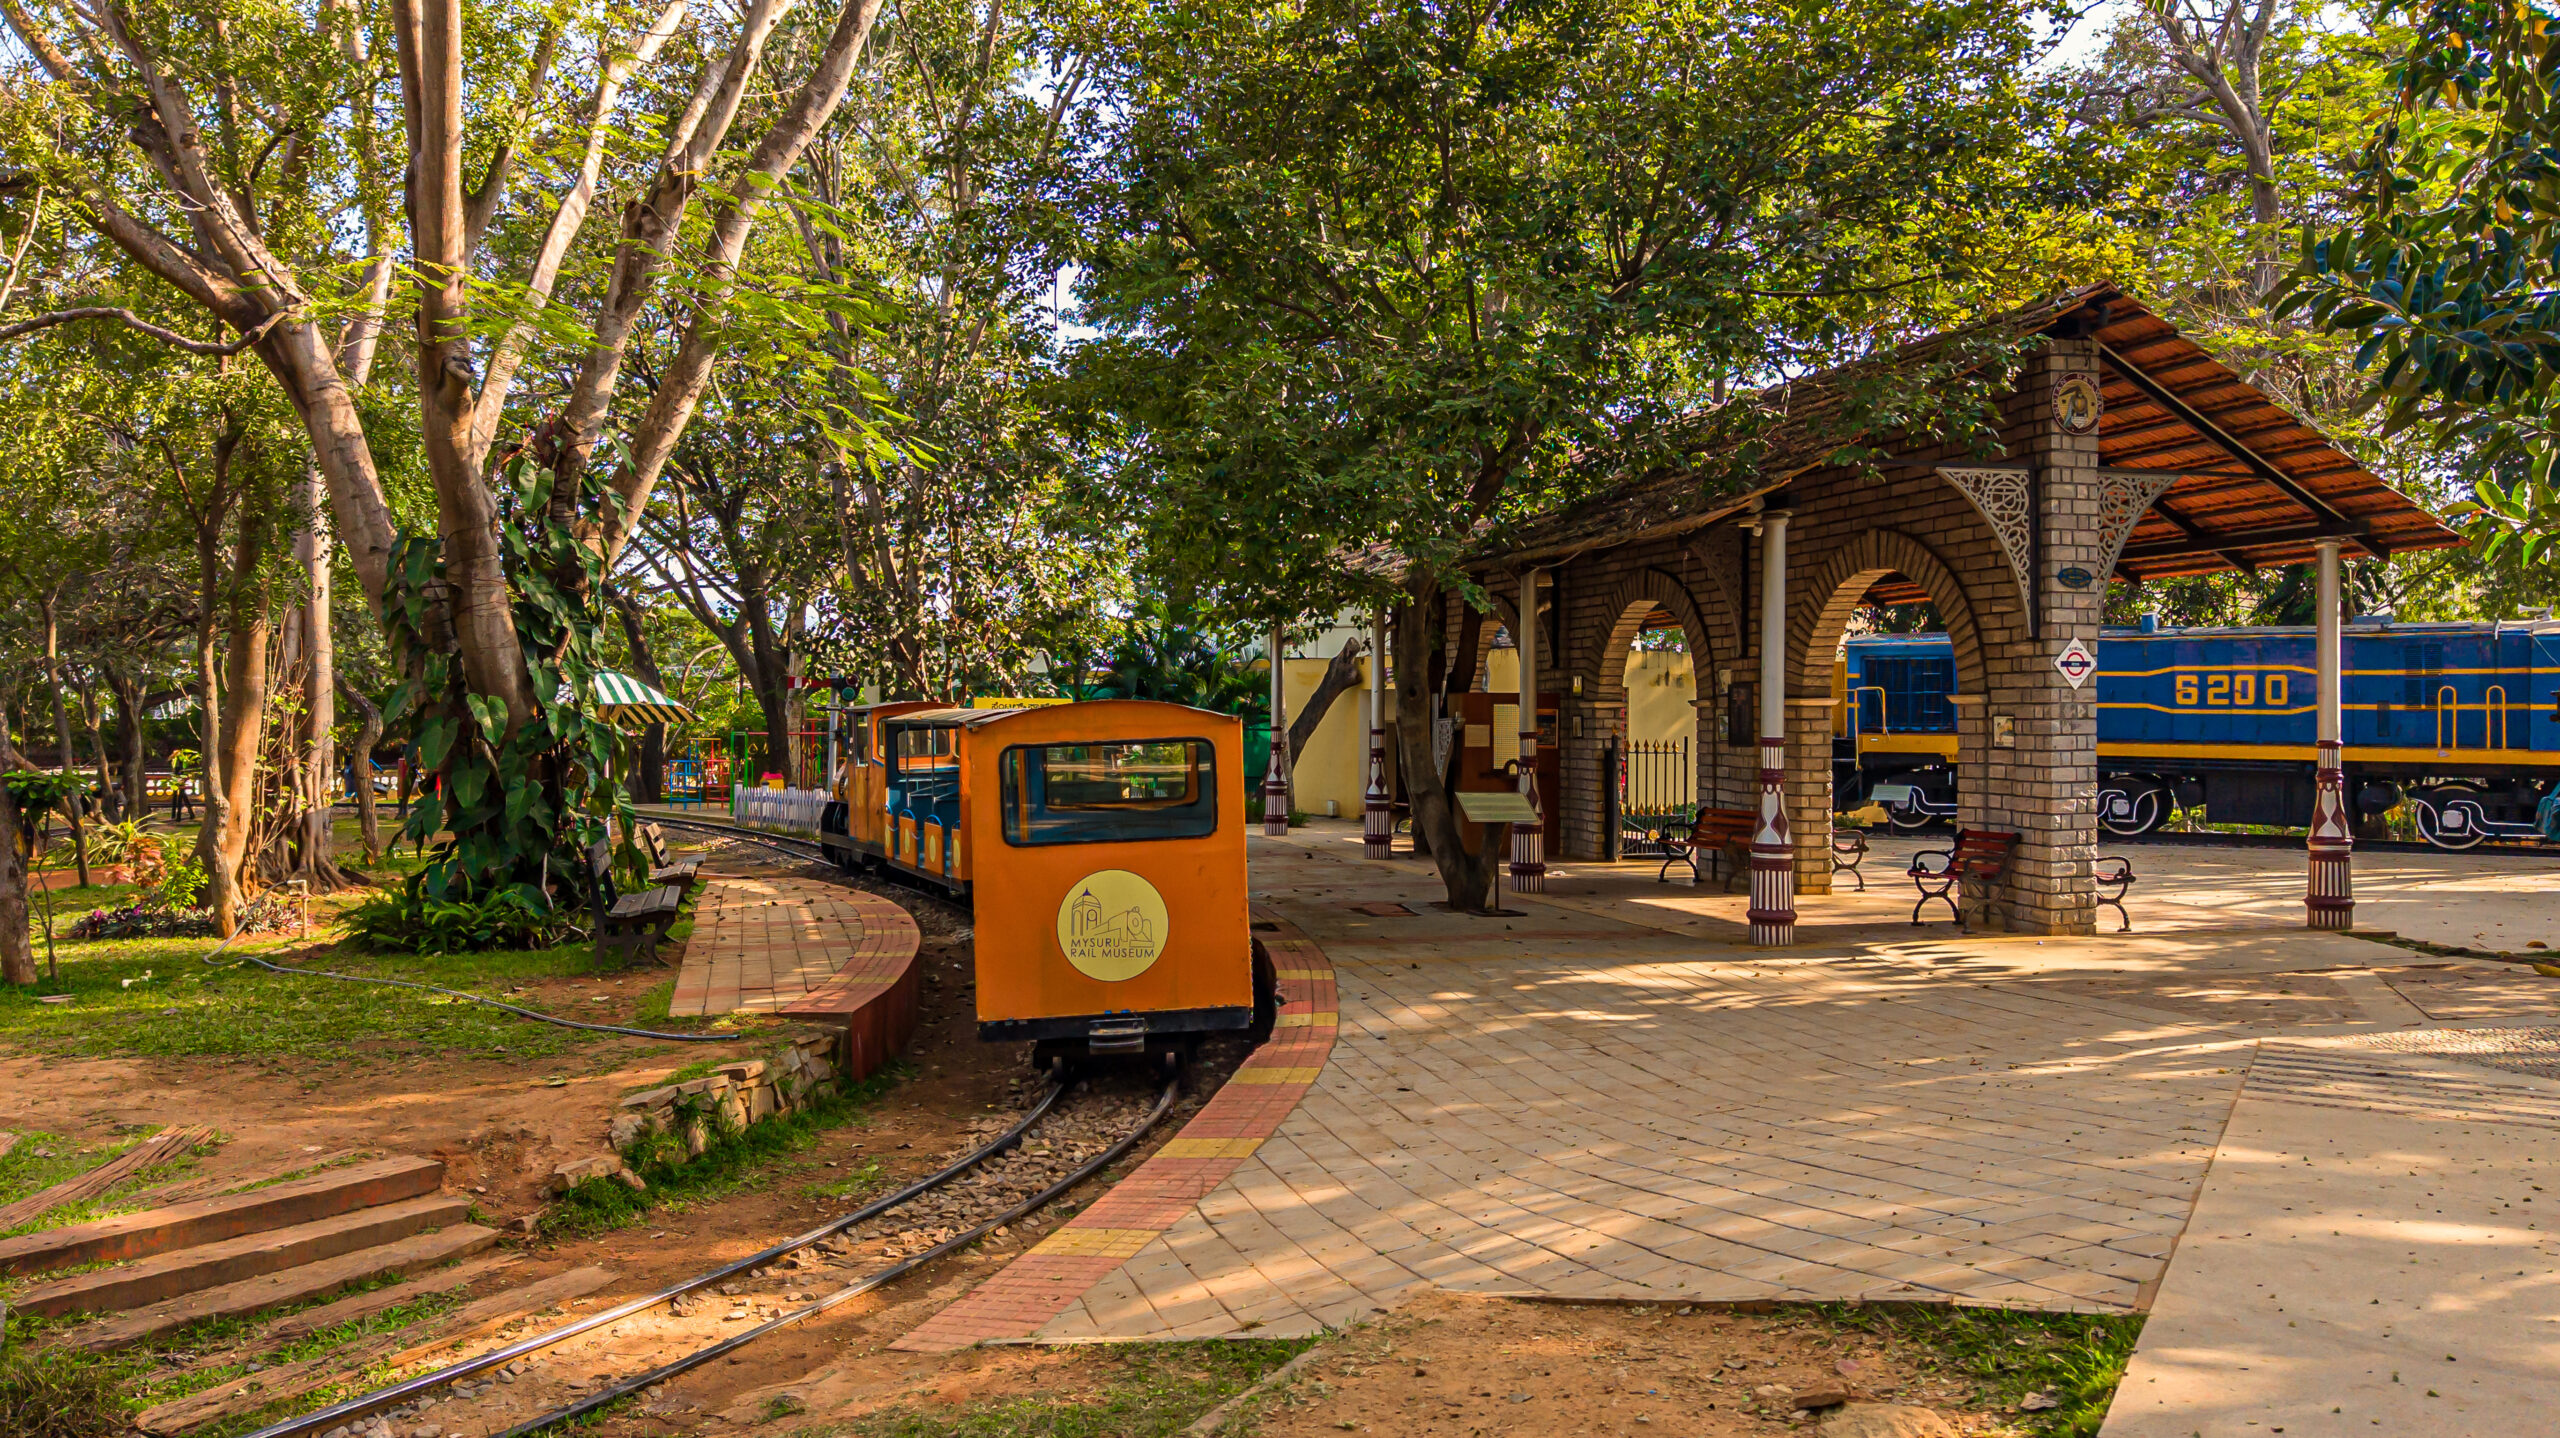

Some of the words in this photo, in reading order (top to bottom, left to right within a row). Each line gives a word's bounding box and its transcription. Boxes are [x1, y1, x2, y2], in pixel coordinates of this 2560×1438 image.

[2176, 674, 2288, 705] 6200
[1071, 938, 1120, 947] MYSURU
[1071, 948, 1096, 957] RAIL
[1102, 948, 1154, 958] MUSEUM
